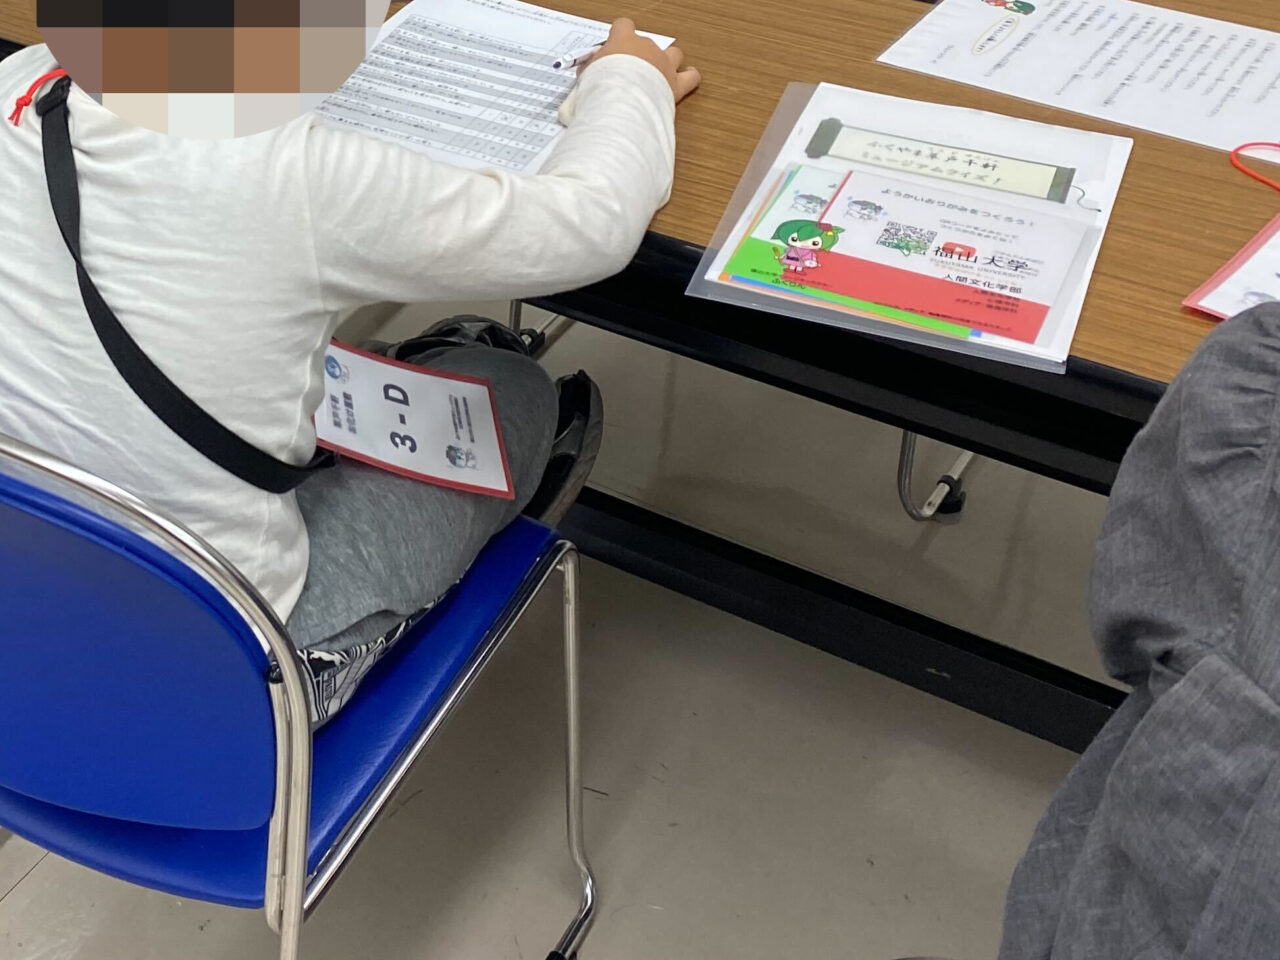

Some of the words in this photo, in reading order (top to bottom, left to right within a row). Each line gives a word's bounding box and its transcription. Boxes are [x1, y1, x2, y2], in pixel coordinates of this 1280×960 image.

[934, 246, 1028, 271] 福山大学
[977, 266, 1026, 279] UNIVERSITY
[944, 274, 1022, 294] 人間文化学部
[383, 383, 409, 406] D
[390, 431, 417, 453] 3
